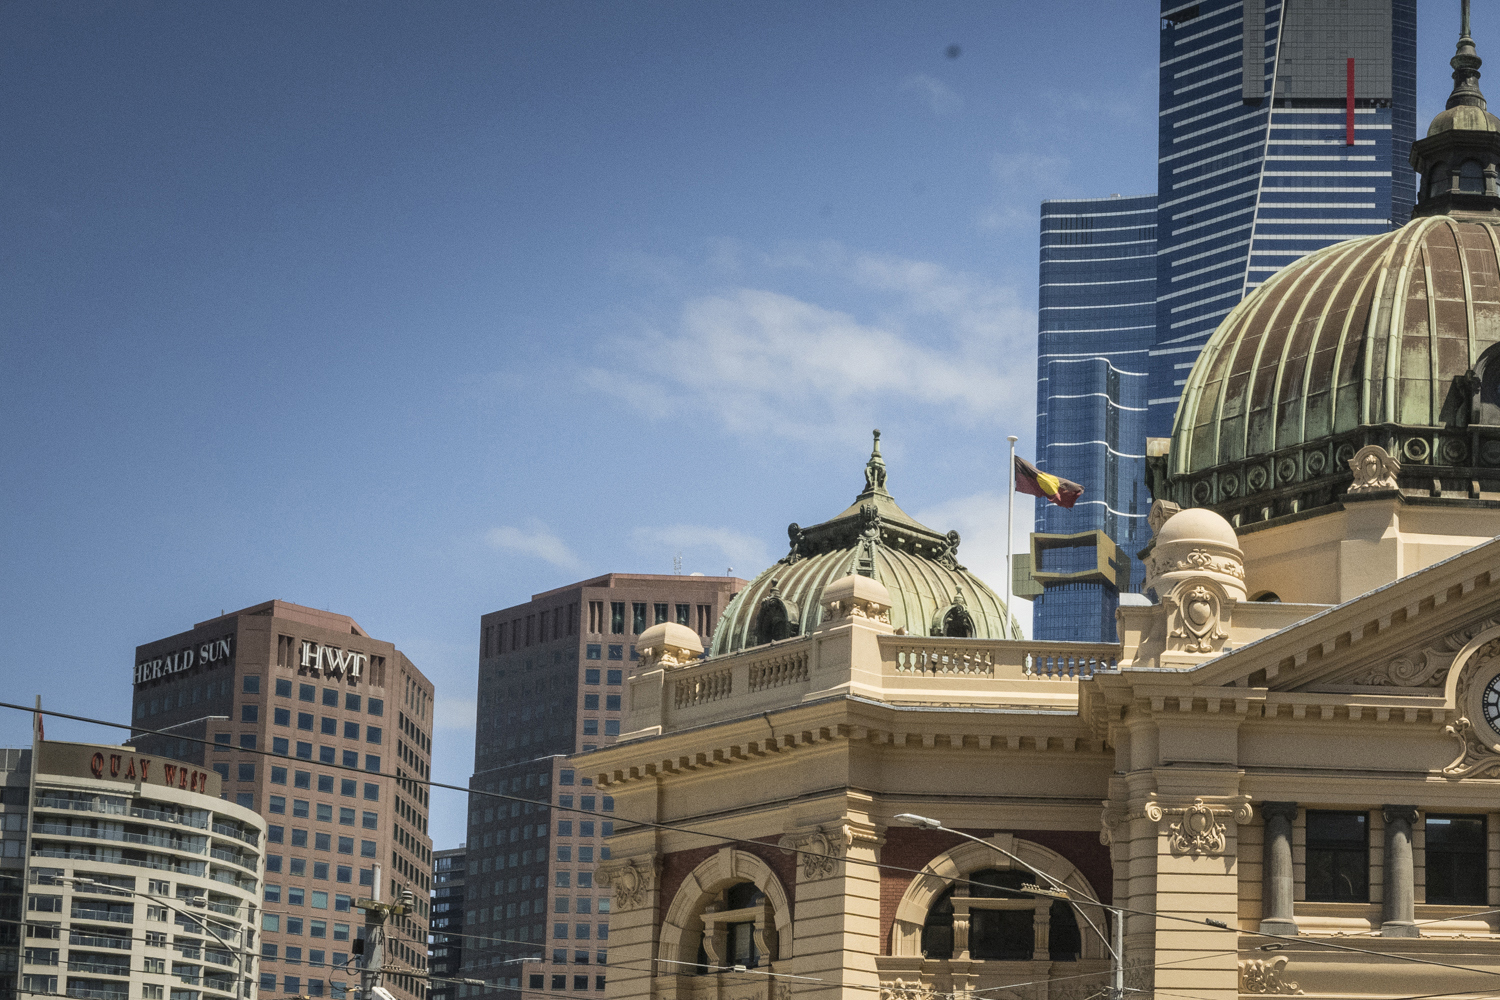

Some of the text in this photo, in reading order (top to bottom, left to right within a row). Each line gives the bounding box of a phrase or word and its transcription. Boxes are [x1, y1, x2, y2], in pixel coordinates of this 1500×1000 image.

[133, 638, 232, 686] HERALD SUN
[301, 641, 368, 677] HWT
[91, 752, 207, 794] QUAY WEST
